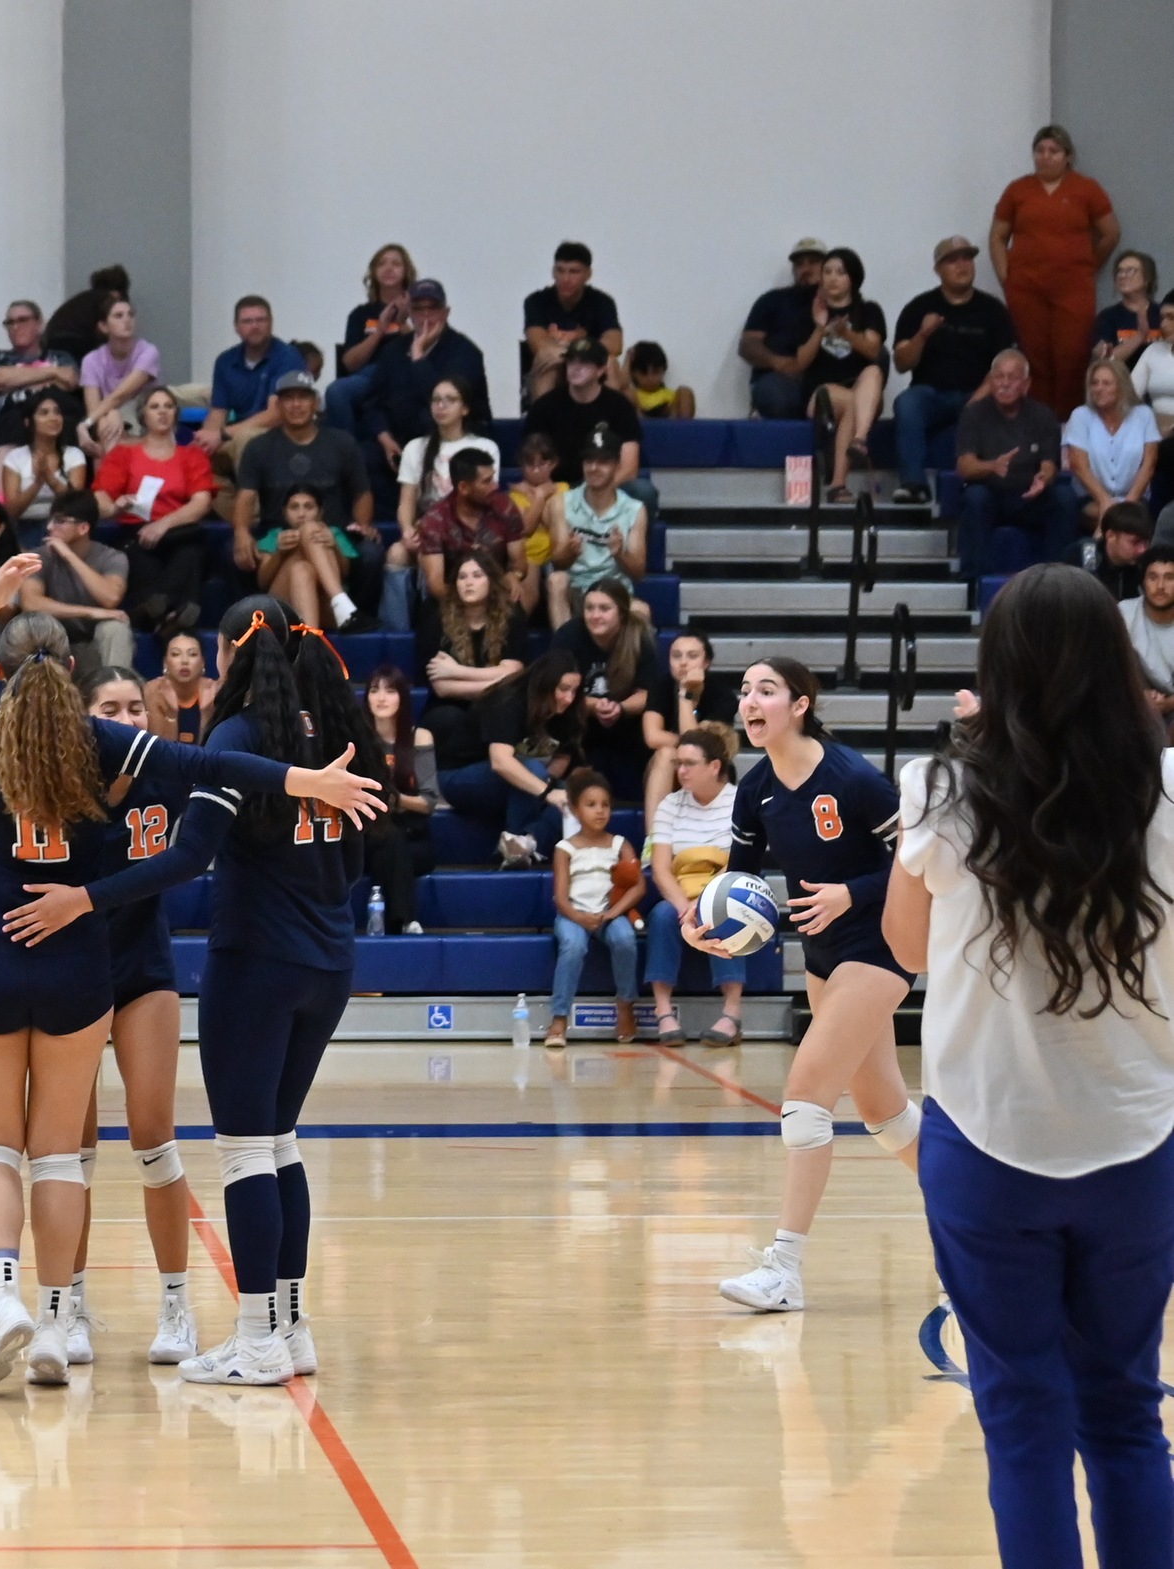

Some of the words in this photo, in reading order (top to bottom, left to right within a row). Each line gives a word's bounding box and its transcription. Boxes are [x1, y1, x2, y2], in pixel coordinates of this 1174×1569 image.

[12, 811, 70, 863] 11
[125, 804, 168, 860] 12
[811, 794, 844, 841] 8
